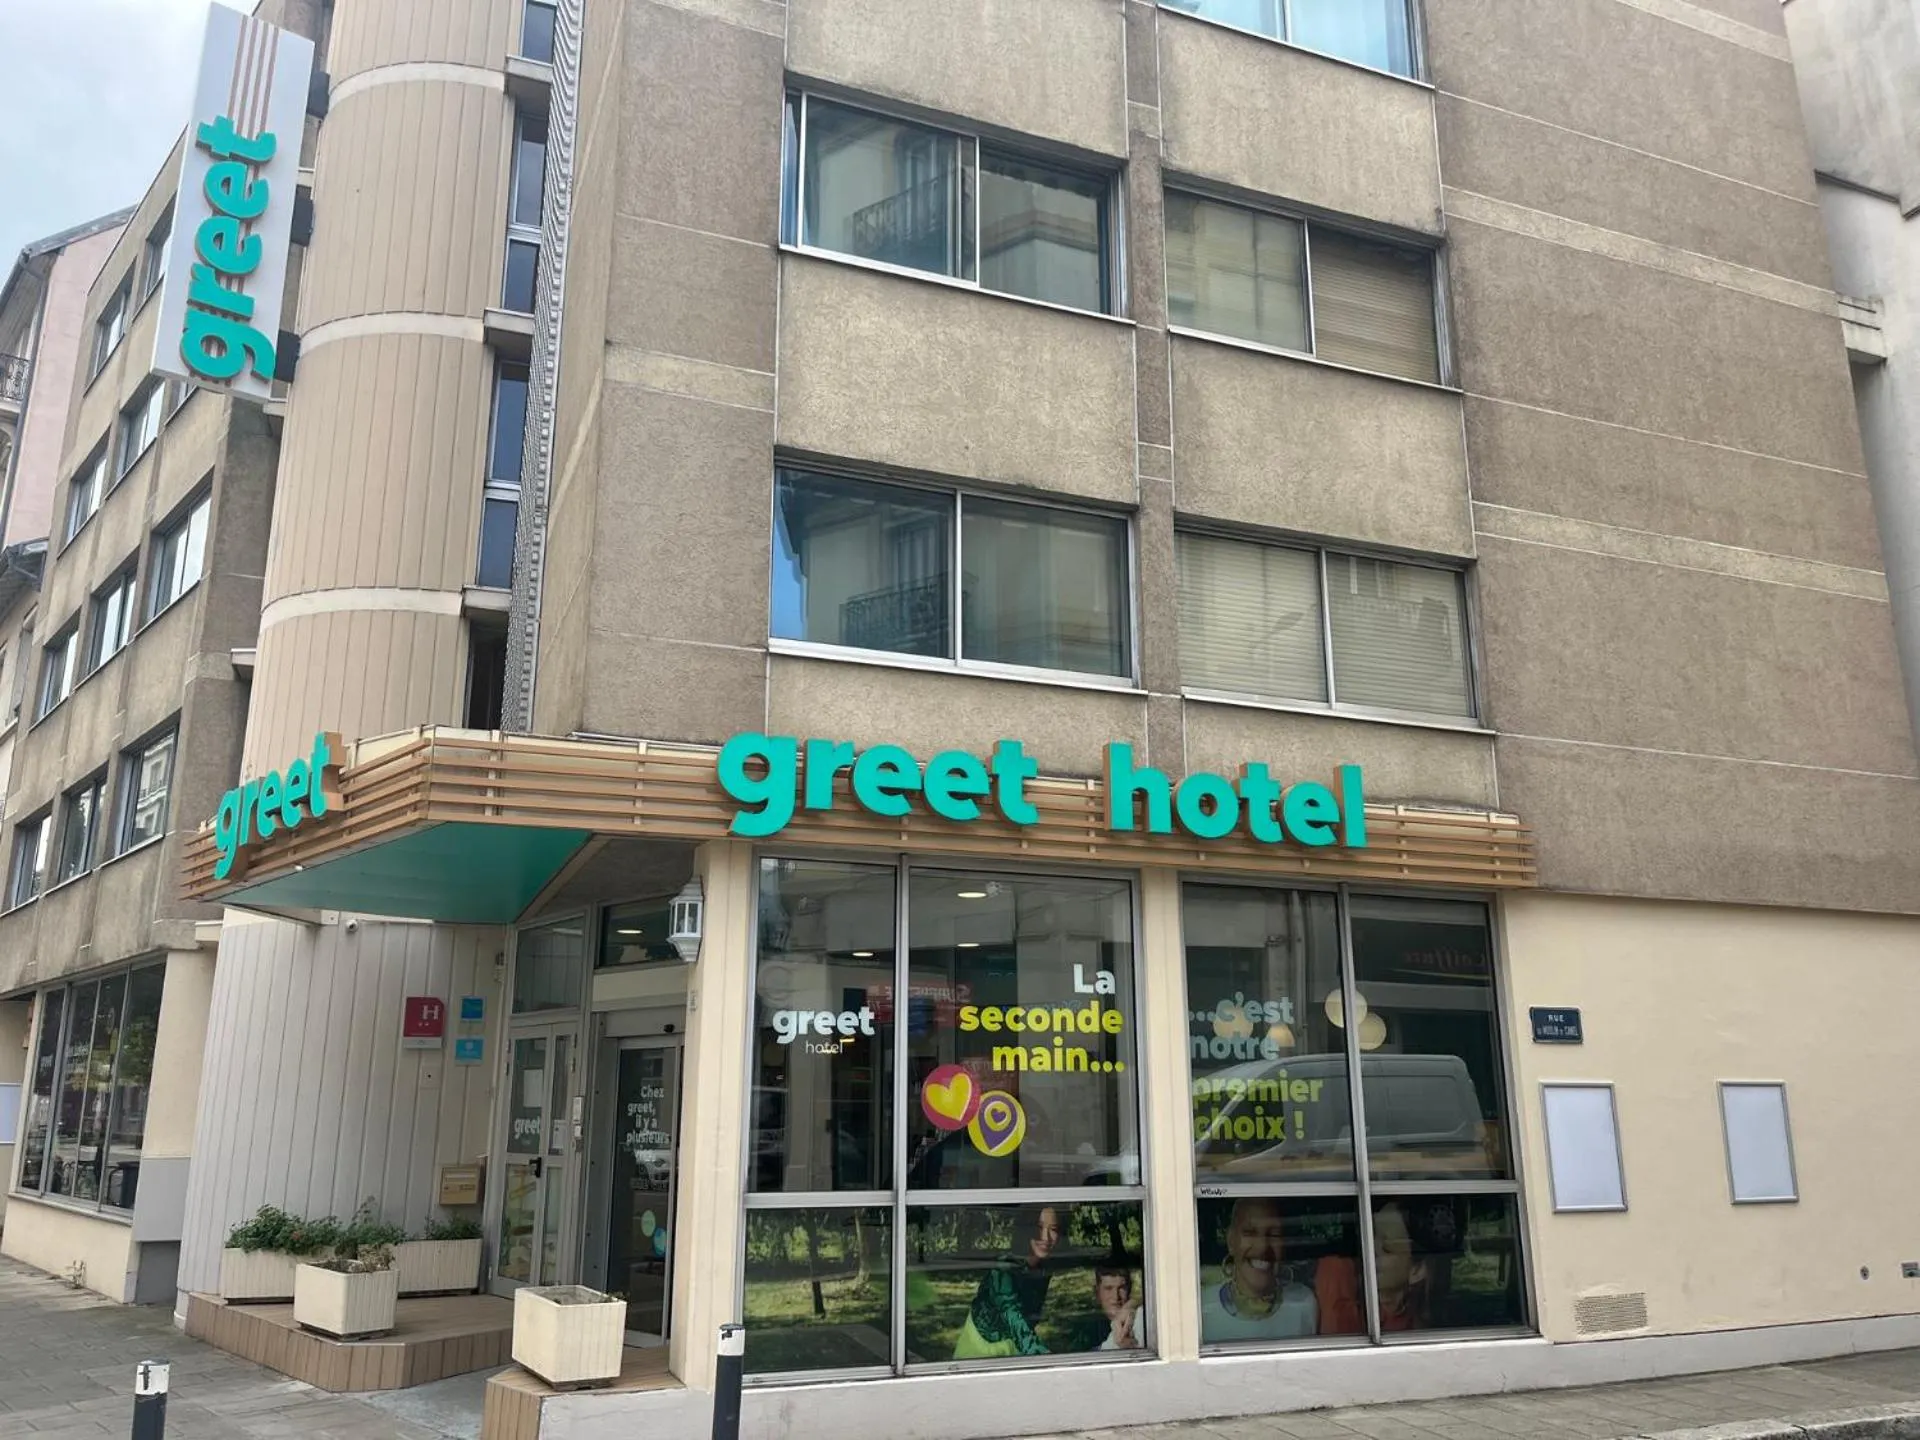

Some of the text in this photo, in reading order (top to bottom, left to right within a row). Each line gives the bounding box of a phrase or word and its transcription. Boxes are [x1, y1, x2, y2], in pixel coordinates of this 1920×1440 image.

[180, 115, 277, 379] greet
[214, 732, 332, 880] greet
[717, 732, 1368, 848] greet hotel
[1073, 963, 1115, 995] La
[772, 1006, 876, 1044] greet
[959, 1000, 1124, 1034] seconde
[1548, 1014, 1565, 1023] RUE
[805, 1039, 844, 1055] hotel
[992, 1036, 1125, 1073] main...
[1190, 1033, 1281, 1061] notre
[640, 1084, 665, 1099] Chez
[1192, 1068, 1325, 1110] premier
[626, 1129, 669, 1147] plusieurs
[1193, 1105, 1287, 1142] choix
